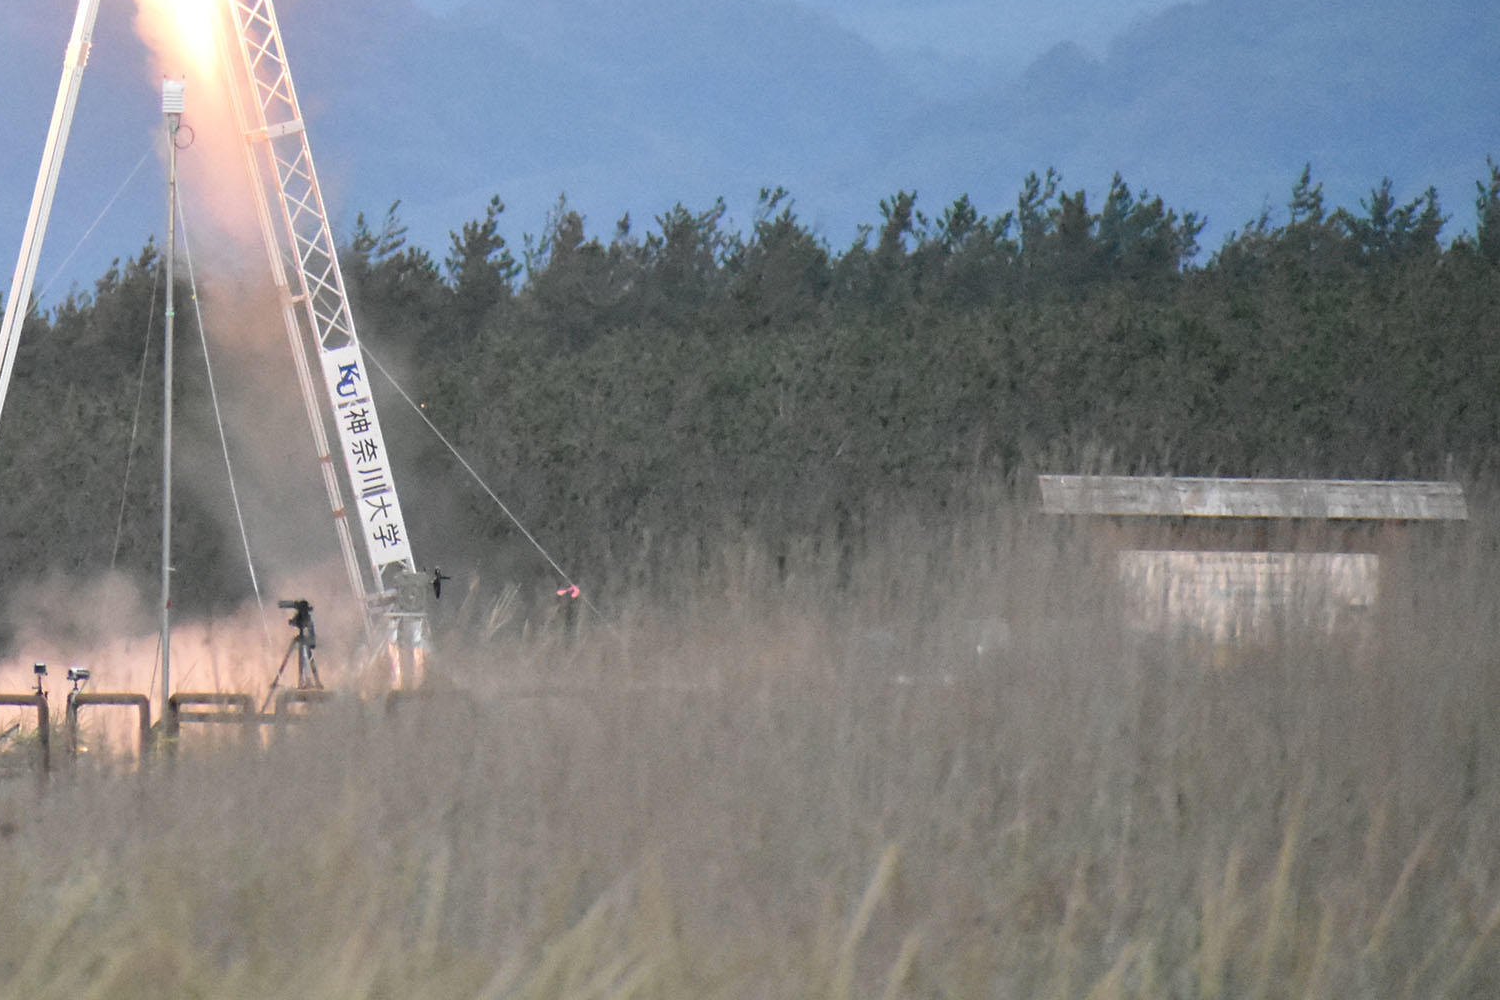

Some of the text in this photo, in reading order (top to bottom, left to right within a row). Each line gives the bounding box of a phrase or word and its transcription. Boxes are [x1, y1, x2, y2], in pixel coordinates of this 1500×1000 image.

[336, 361, 361, 398] KU
[344, 408, 402, 548] 神奈川大学
